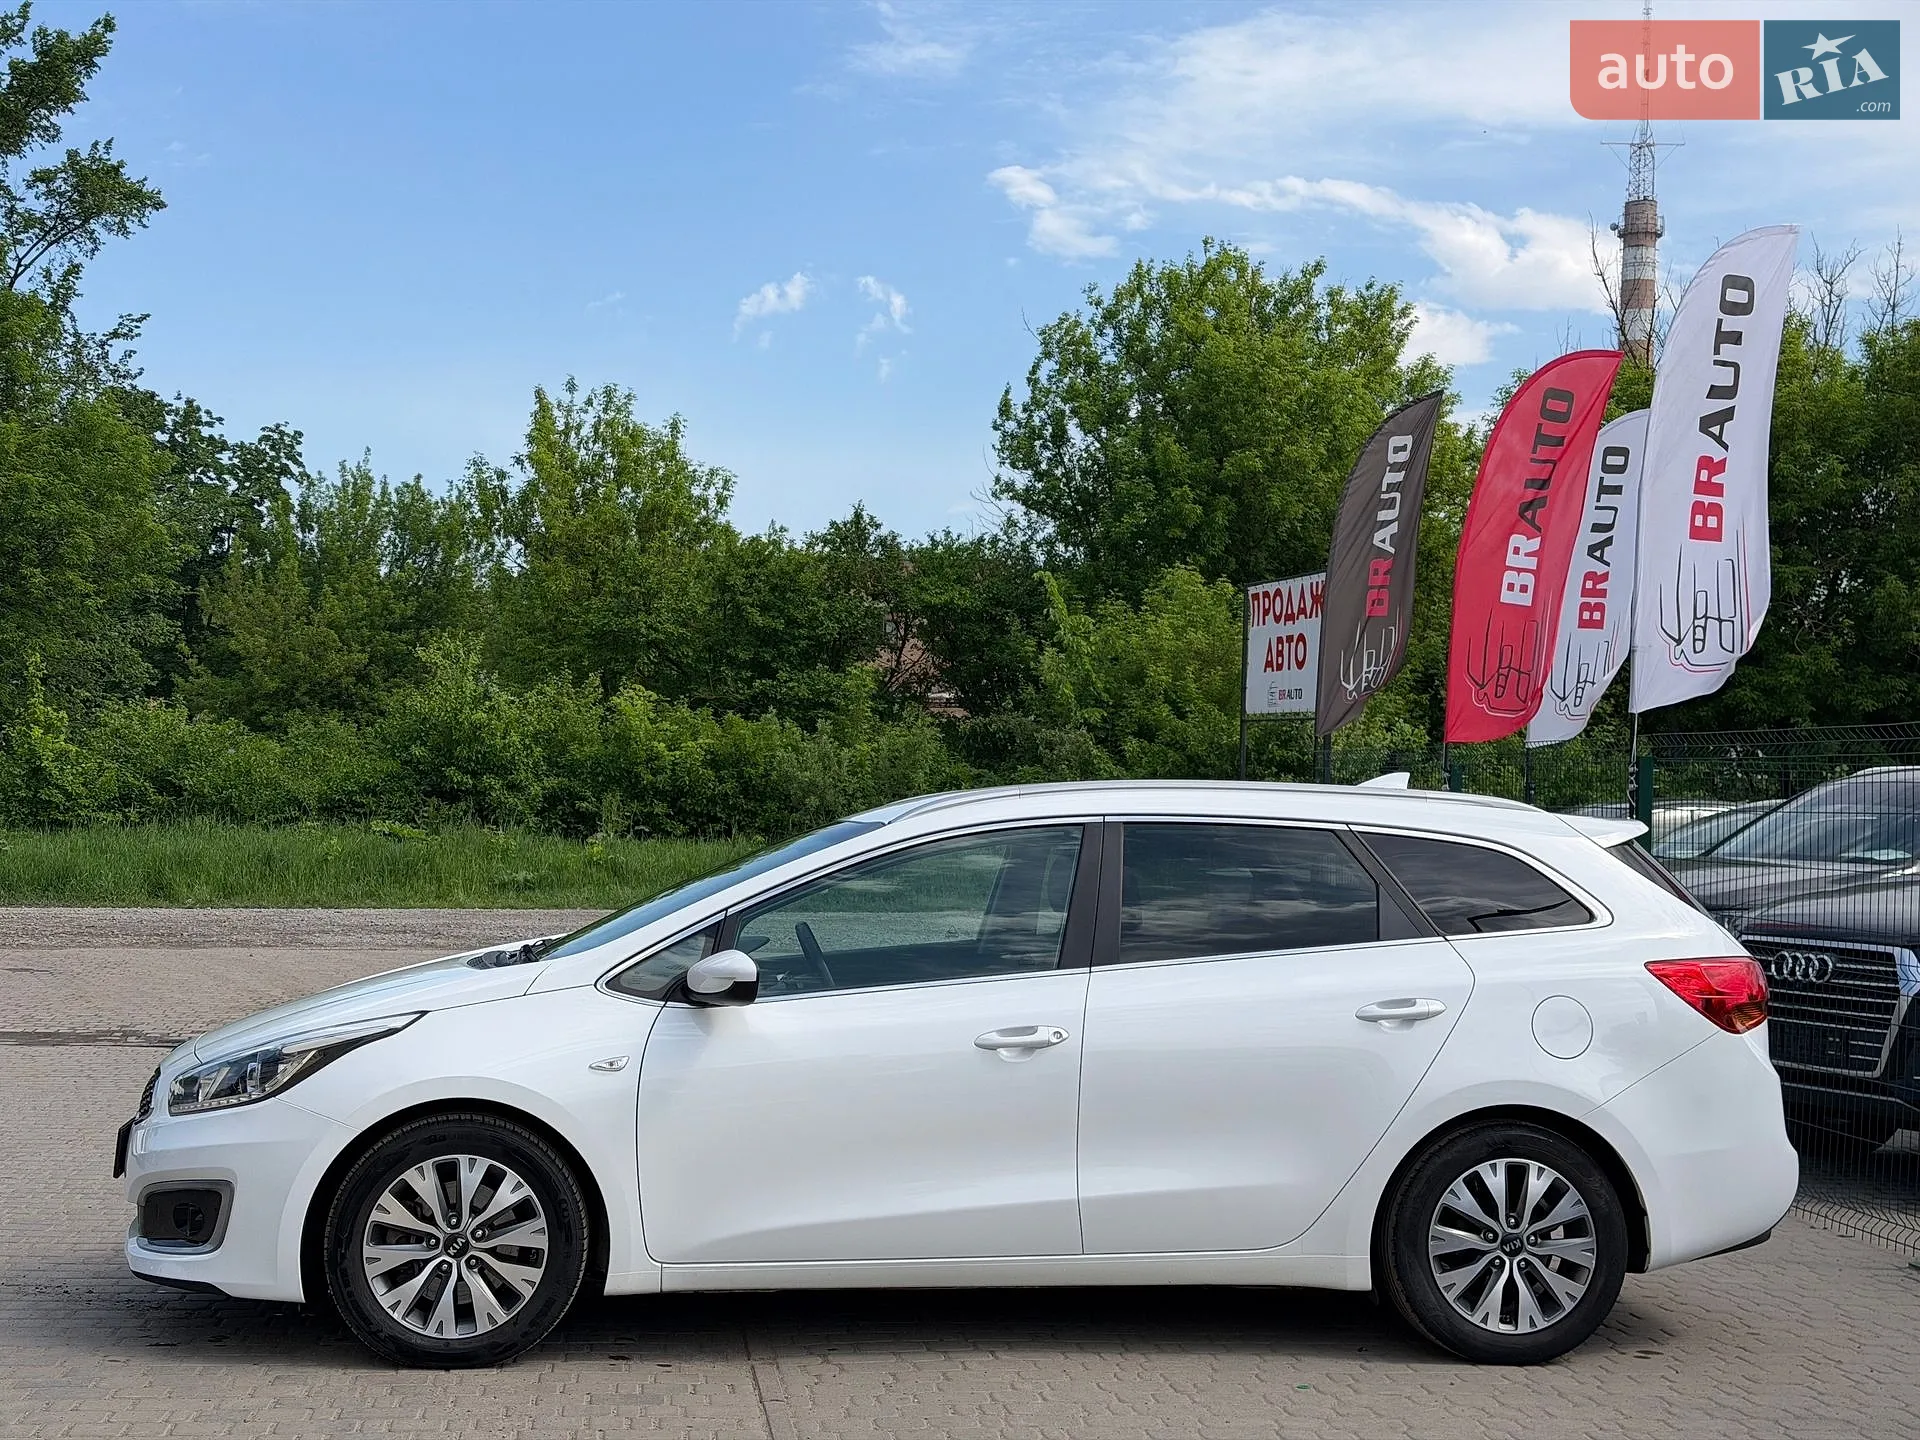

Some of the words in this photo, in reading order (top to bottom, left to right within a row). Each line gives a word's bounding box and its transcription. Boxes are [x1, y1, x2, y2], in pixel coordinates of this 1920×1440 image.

[1689, 274, 1755, 543] BRAUTO
[1366, 434, 1414, 617] BRAUTO
[1500, 388, 1575, 606] BRAUTO
[1578, 446, 1630, 630] BRAUTO
[1251, 581, 1326, 627] ПРОДАЖ
[1263, 632, 1308, 673] АВТО
[447, 1237, 466, 1256] KIA
[1502, 1238, 1522, 1252] KIA
